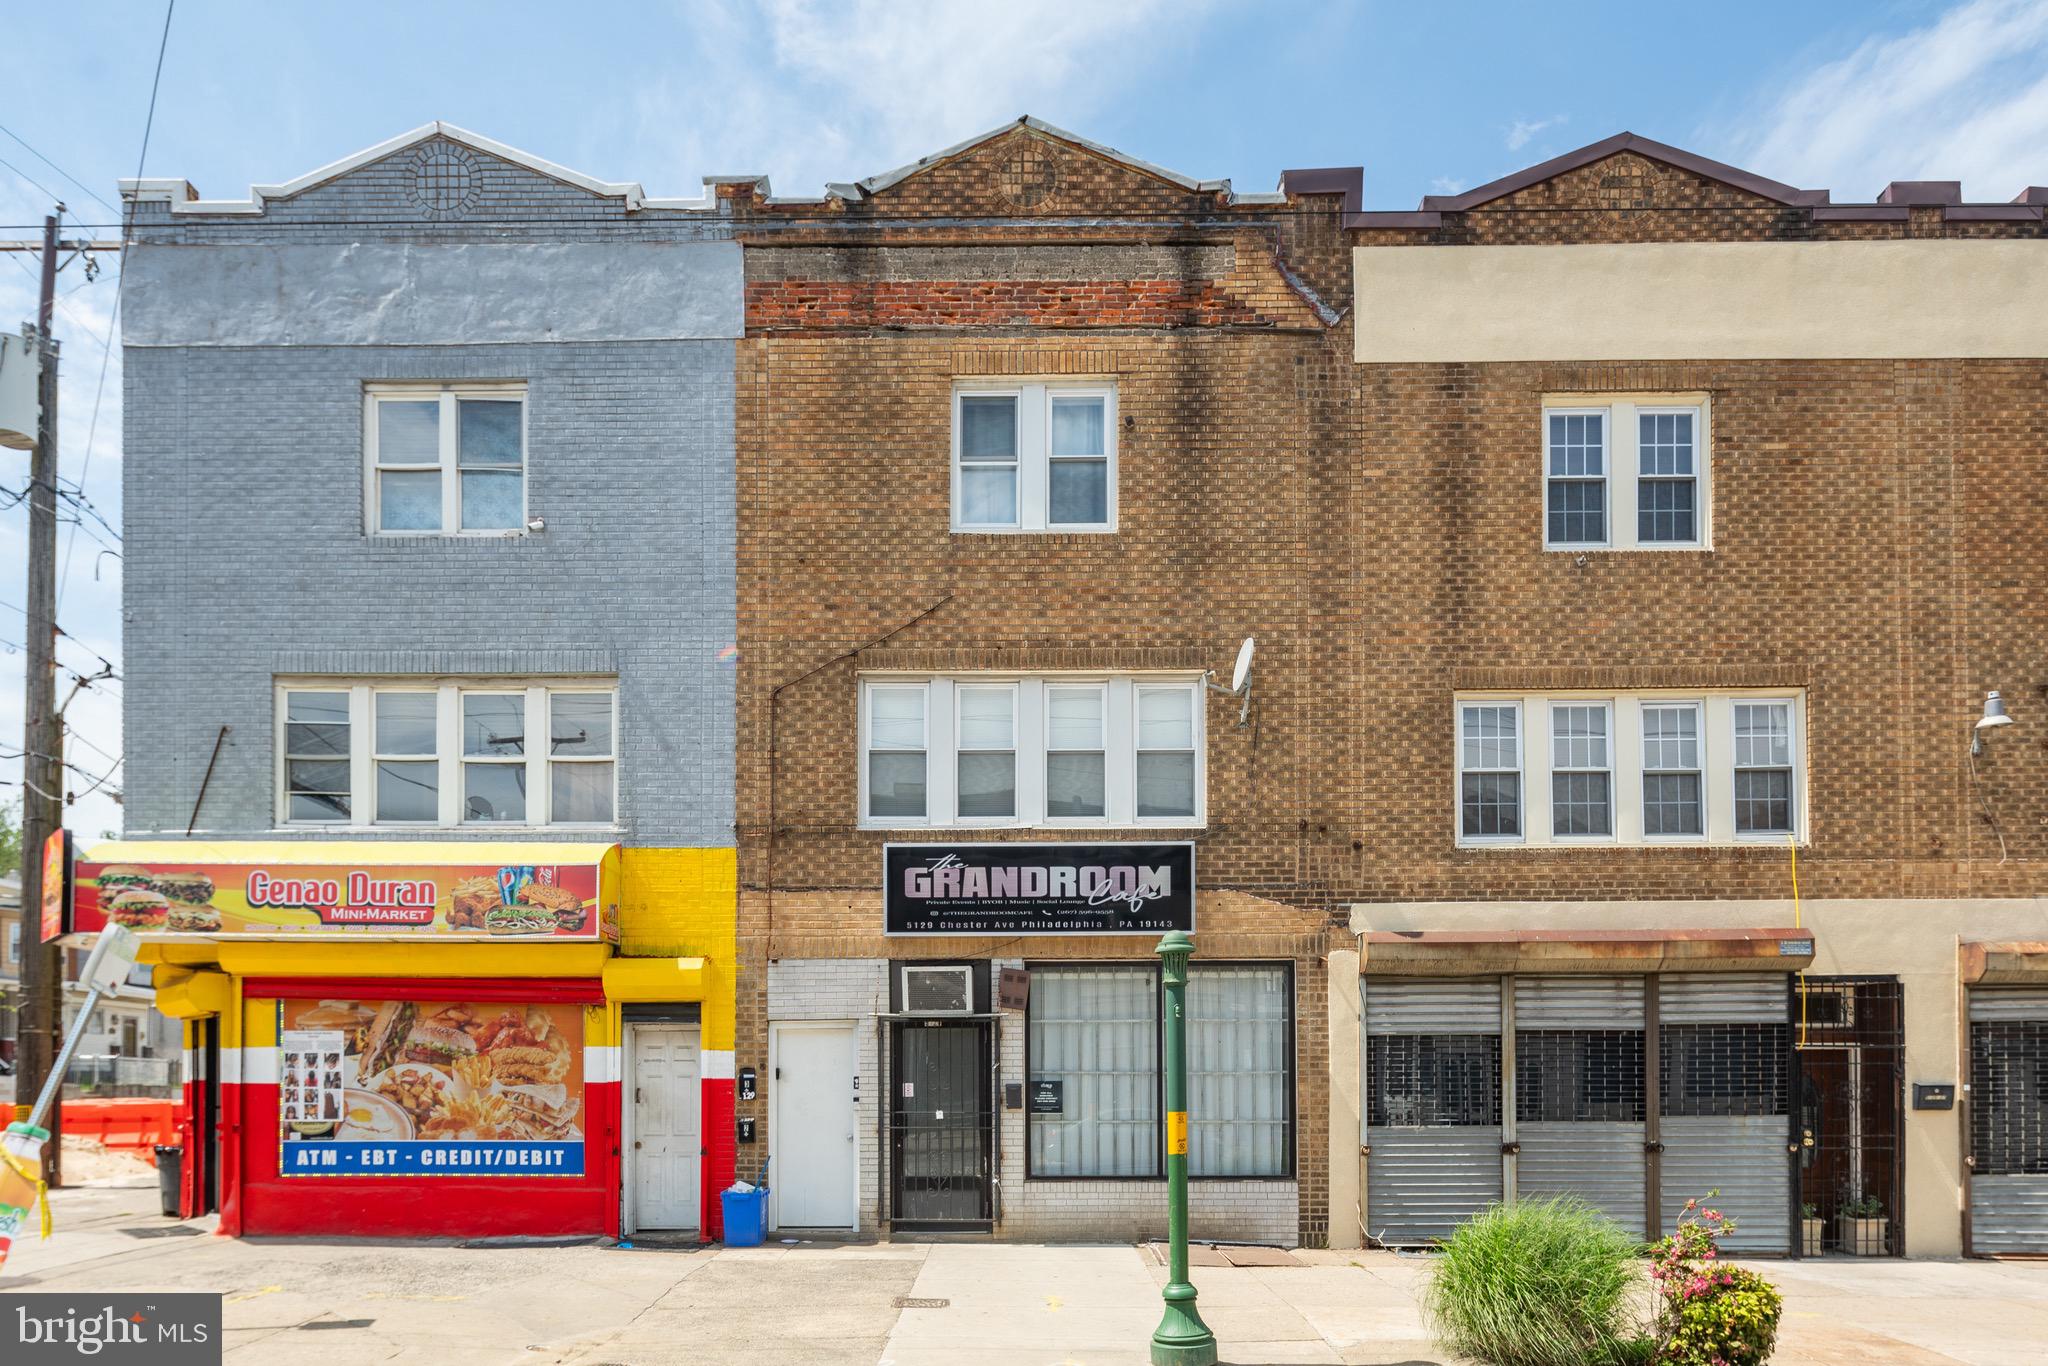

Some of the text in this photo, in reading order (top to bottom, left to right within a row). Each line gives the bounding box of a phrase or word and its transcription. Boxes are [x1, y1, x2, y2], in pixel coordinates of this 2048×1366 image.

[247, 870, 437, 908] Genao Duran
[904, 866, 1171, 898] GRANDROOM
[906, 921, 934, 929] 5129
[940, 921, 988, 929] Chester
[994, 920, 1015, 929] Ave
[1021, 920, 1102, 929] Philadelphia
[1119, 920, 1133, 928] PA
[1139, 920, 1174, 928] 19143
[296, 1149, 338, 1166] ATM
[361, 1149, 398, 1166] EBT
[420, 1149, 565, 1166] CREDIT/DEBIT
